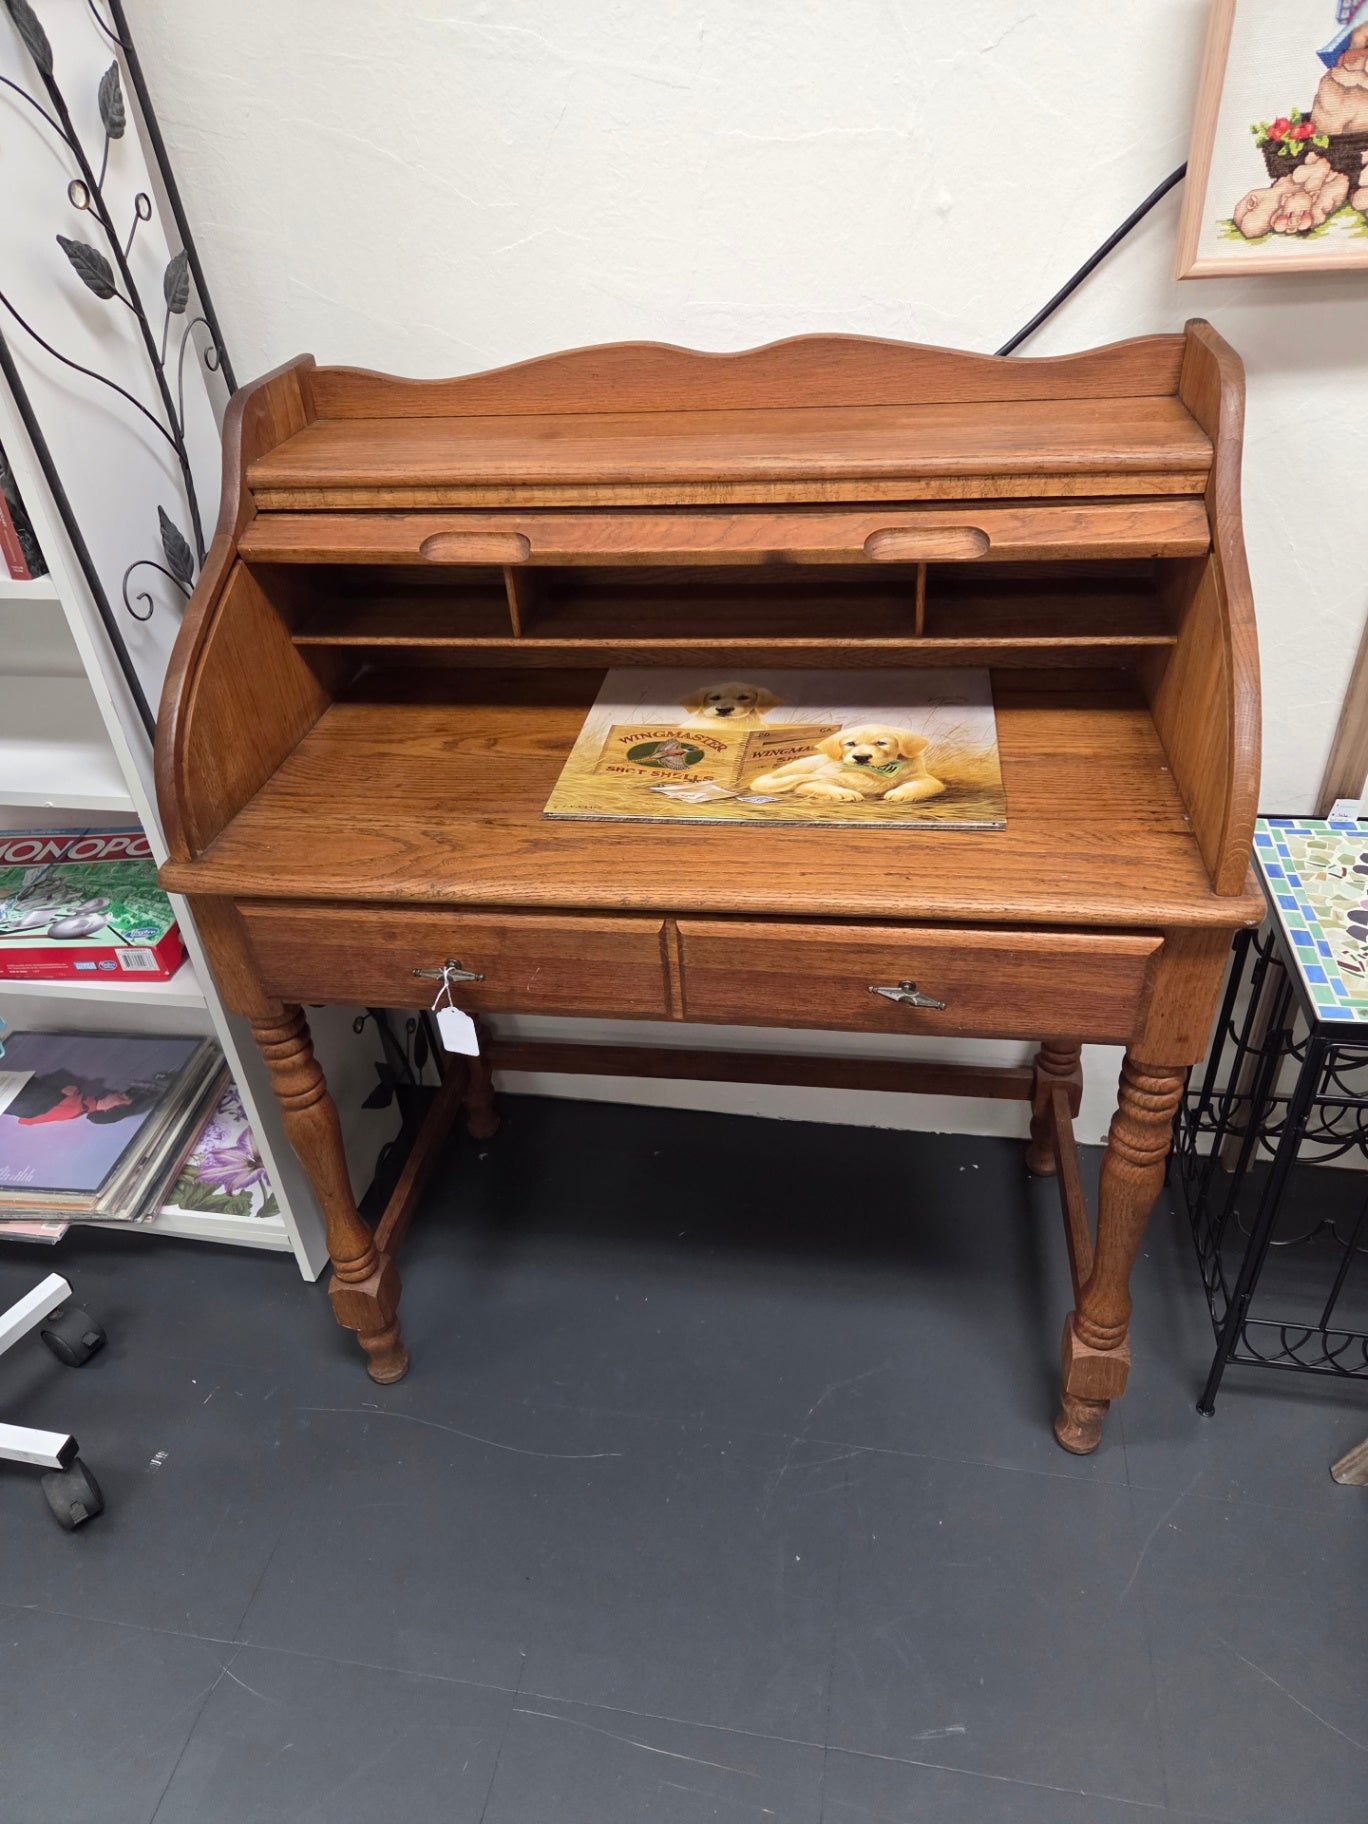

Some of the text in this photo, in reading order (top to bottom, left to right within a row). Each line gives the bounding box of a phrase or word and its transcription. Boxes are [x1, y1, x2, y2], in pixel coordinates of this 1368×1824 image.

[619, 730, 728, 752] WINGMASTER
[606, 765, 715, 783] SHOT SHELLS
[0, 840, 151, 862] ONOPO
